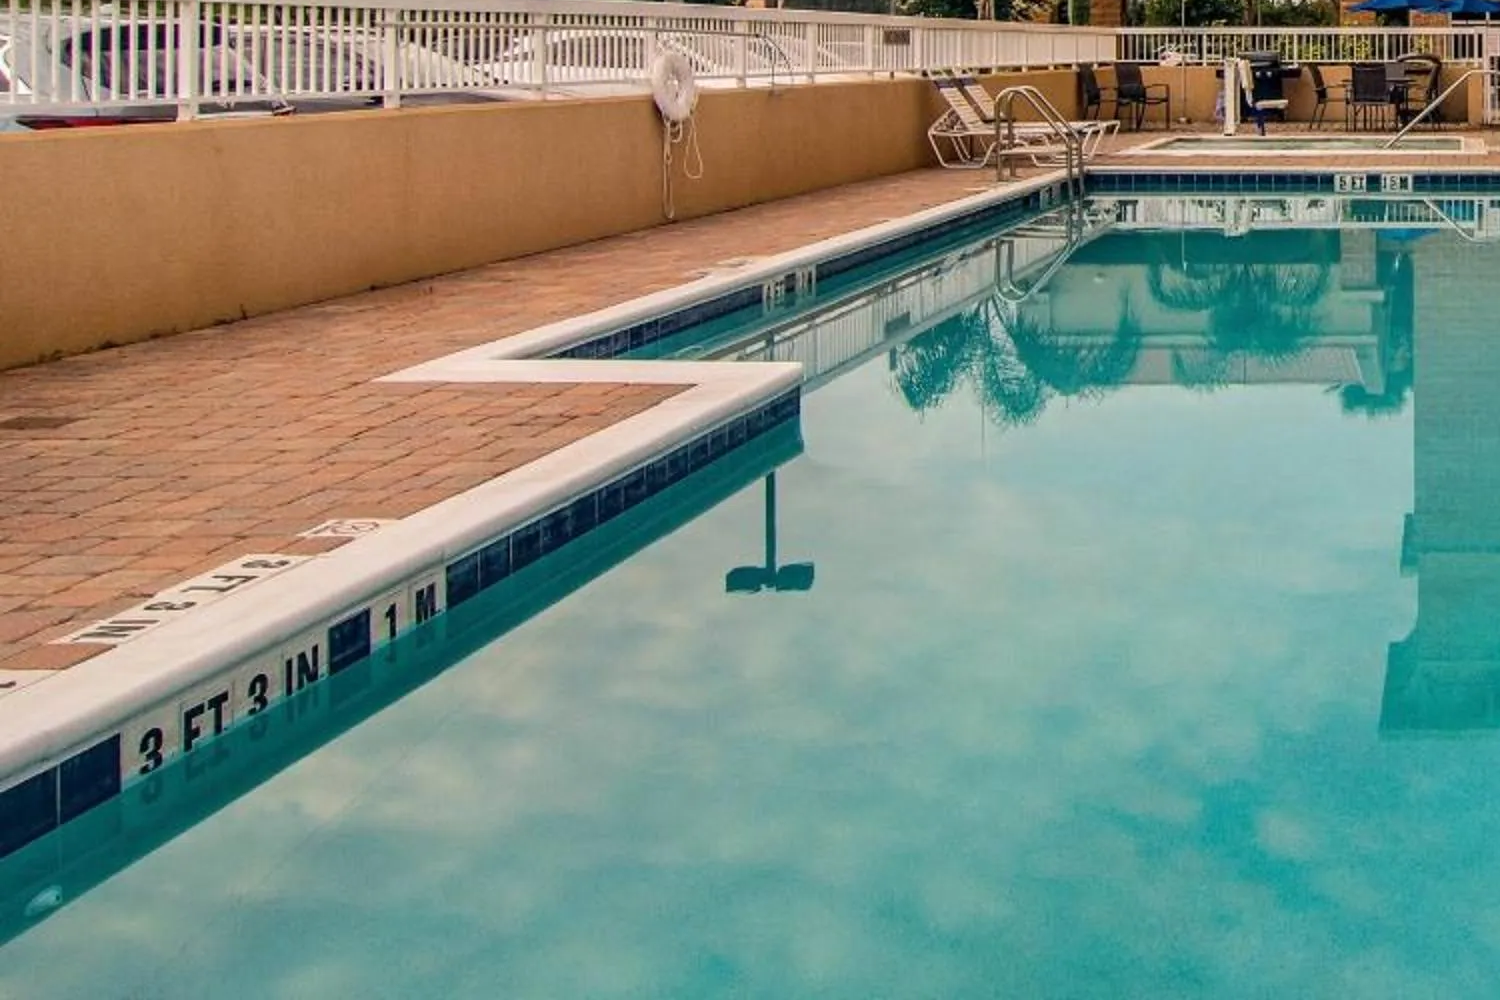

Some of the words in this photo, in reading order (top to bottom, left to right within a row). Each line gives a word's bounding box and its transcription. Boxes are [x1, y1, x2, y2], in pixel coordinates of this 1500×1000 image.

[385, 602, 397, 638] 1
[139, 727, 163, 775] 3
[247, 673, 268, 716] 3
